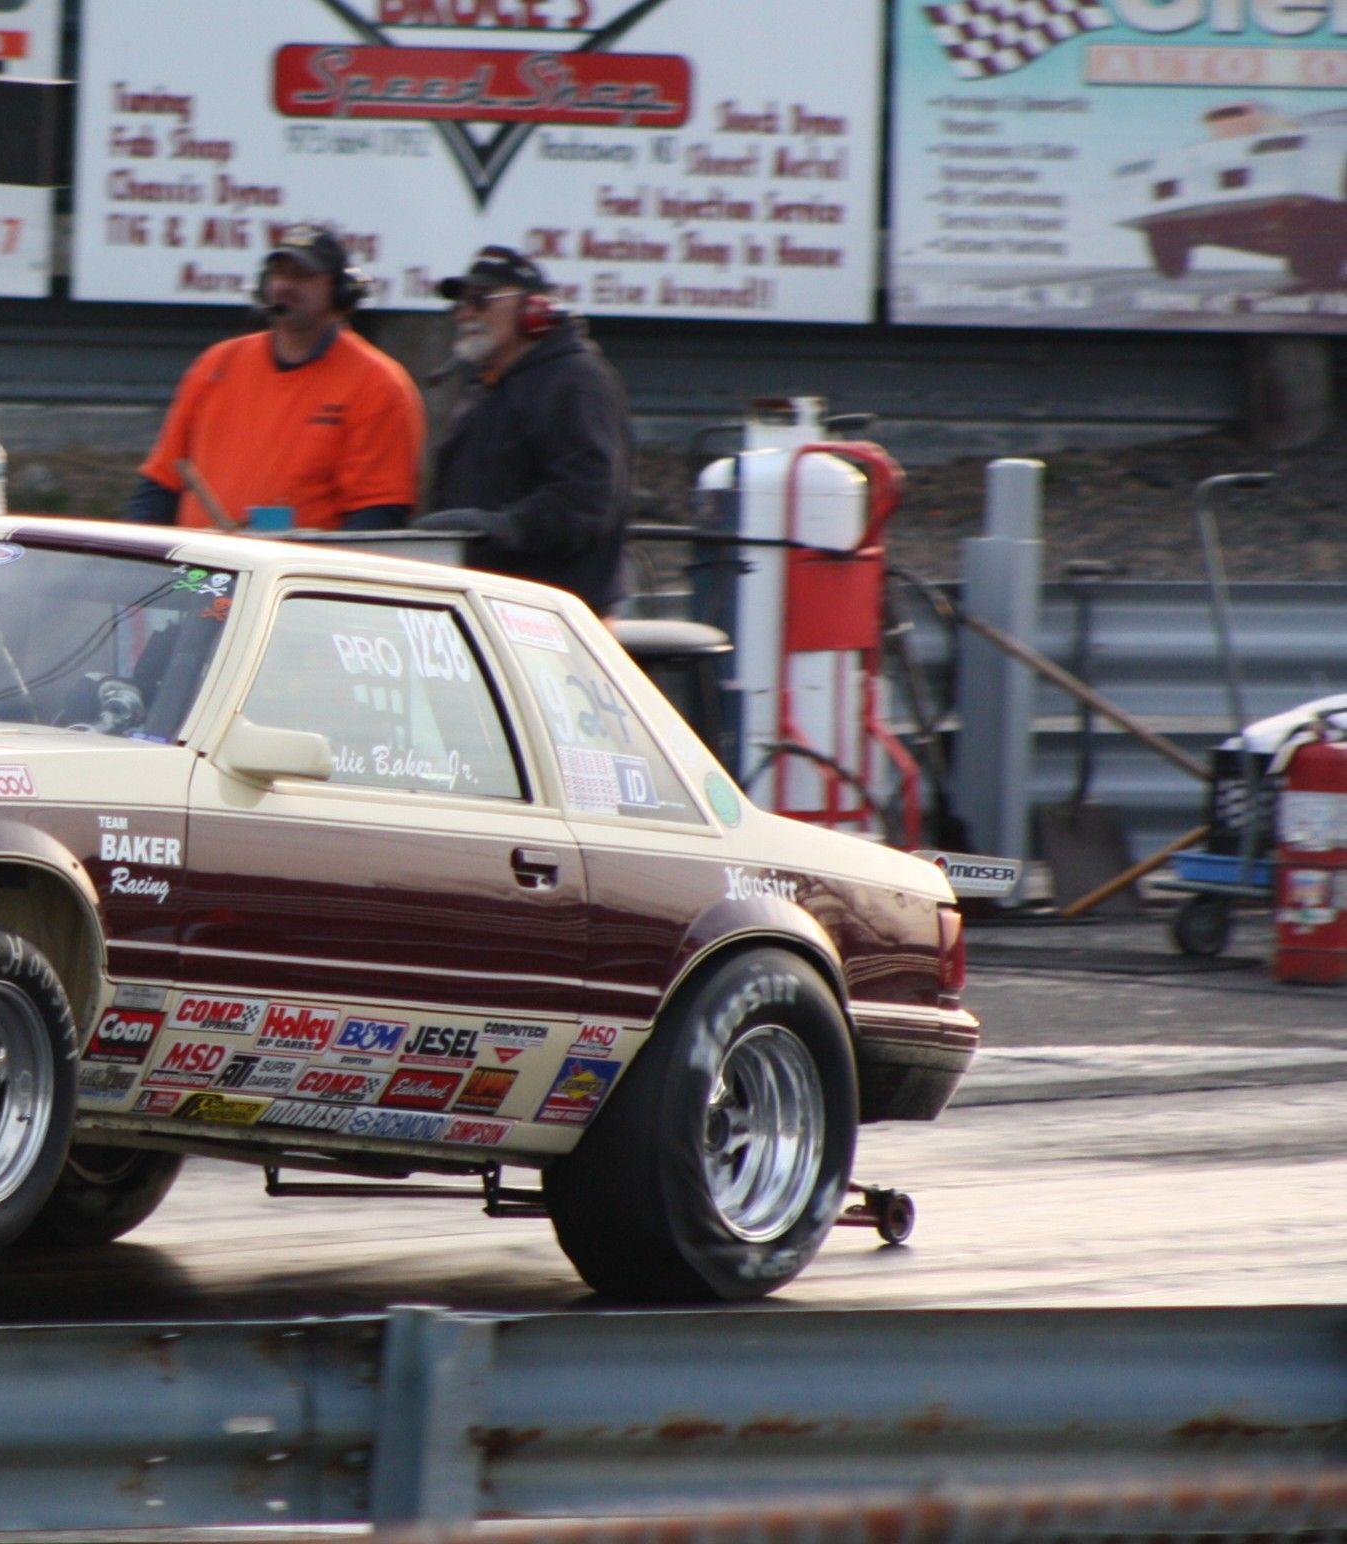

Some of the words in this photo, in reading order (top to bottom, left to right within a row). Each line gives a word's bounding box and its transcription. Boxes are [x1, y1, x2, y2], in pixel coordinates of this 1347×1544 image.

[110, 80, 193, 123] Tuning
[293, 46, 502, 119] Speed
[510, 52, 680, 129] Shop
[110, 126, 156, 157] Fab
[169, 126, 234, 164] Shop
[107, 168, 201, 204] Chassis
[656, 186, 754, 227] Injection
[762, 190, 846, 224] Service
[105, 213, 151, 247] TIG
[678, 231, 732, 270] Shop
[593, 272, 647, 303] Else
[332, 633, 403, 678] PRO
[372, 745, 433, 777] Baker
[447, 749, 479, 792] Jr.
[625, 768, 648, 802] ID
[98, 815, 128, 830] TEAM
[101, 834, 182, 866] BAKER
[111, 866, 170, 904] Racing
[724, 865, 798, 902] Hoosier
[950, 865, 1014, 881] MOSER
[97, 1012, 155, 1043] Coan
[176, 998, 245, 1023] COMP
[261, 1006, 336, 1051] Holley
[336, 1021, 406, 1051] B&M
[405, 1025, 479, 1059] JESEL
[483, 1021, 549, 1038] COMPUTECH
[577, 1024, 619, 1047] MSD
[160, 1042, 227, 1072] MSD
[260, 1060, 297, 1074] SUPER
[296, 1070, 366, 1094] COMP
